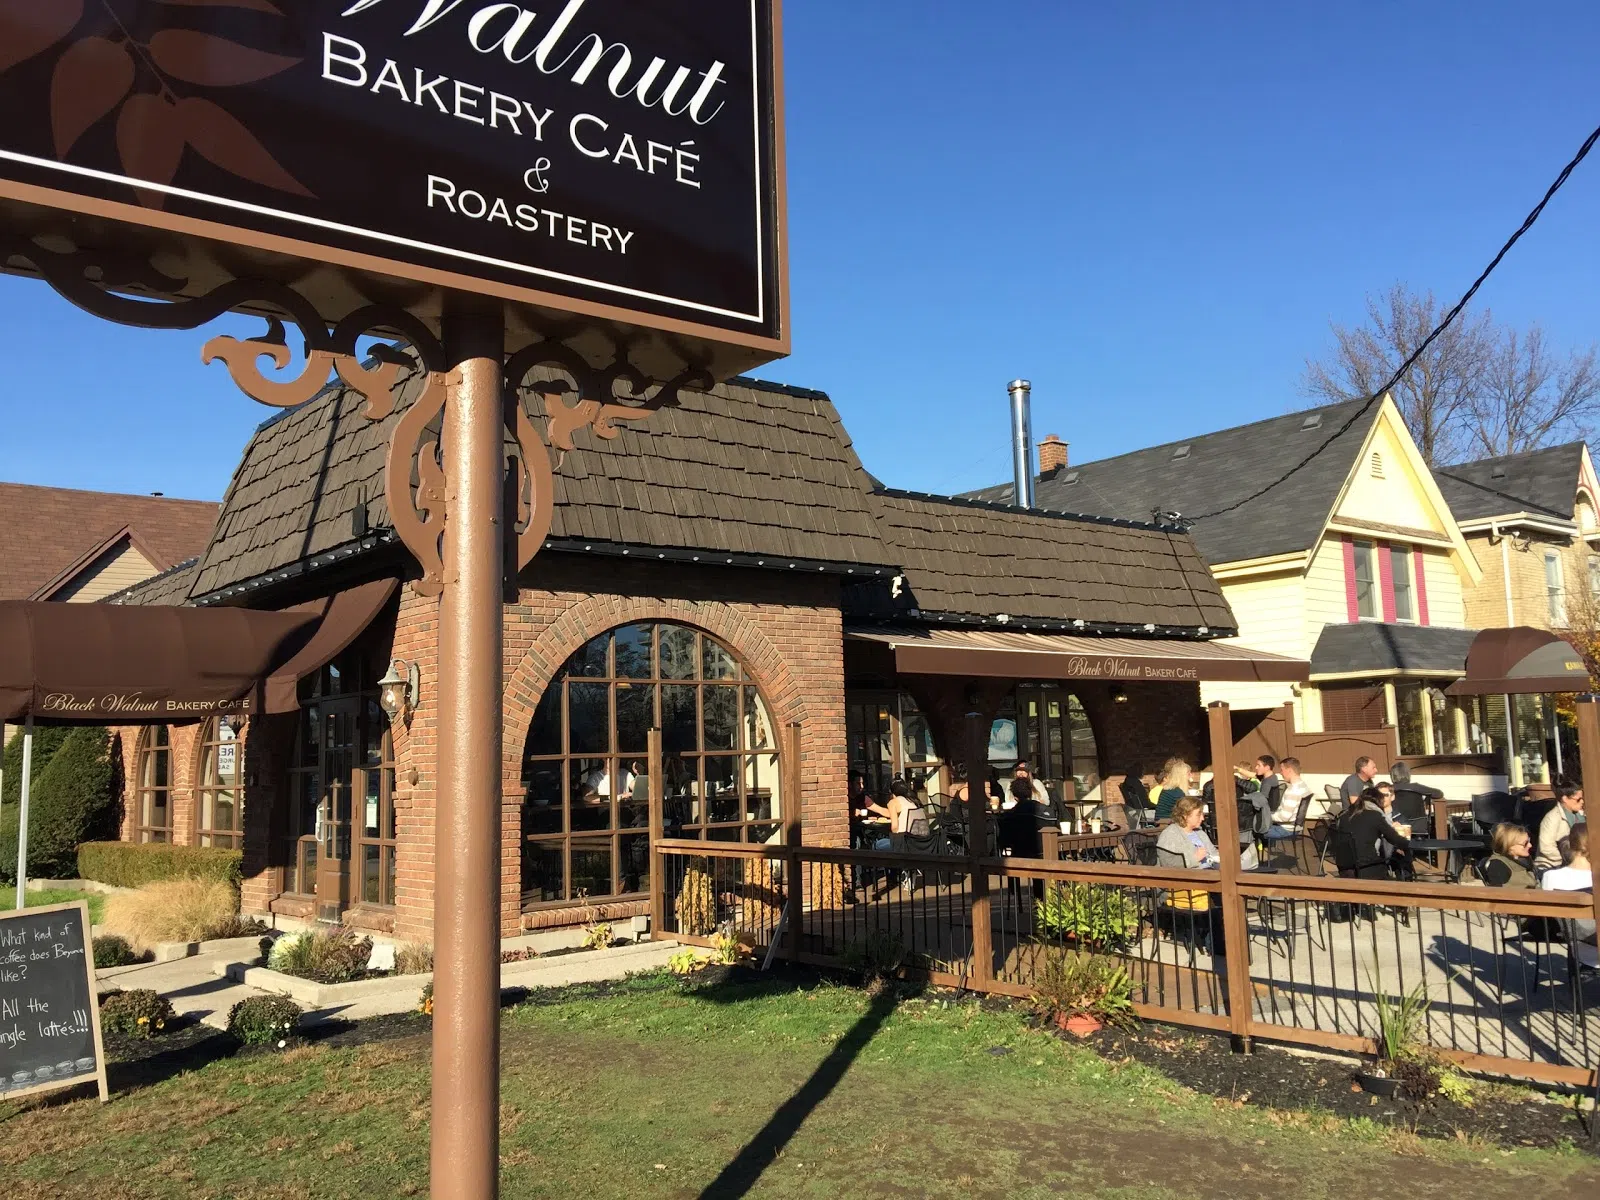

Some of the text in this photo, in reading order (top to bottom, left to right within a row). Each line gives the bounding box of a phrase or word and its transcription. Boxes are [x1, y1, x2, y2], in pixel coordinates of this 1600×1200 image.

[320, 31, 702, 190] BAKERY CAFÉ
[523, 157, 551, 194] &
[426, 174, 634, 255] ROASTERY
[1067, 656, 1198, 679] Black Walnut BAKERY CAFÉ
[42, 692, 96, 712] Black
[100, 691, 159, 712] Walnut
[166, 700, 216, 711] BAKERY
[0, 928, 26, 947] What
[60, 922, 73, 936] of
[0, 948, 26, 965] coffee
[29, 949, 50, 961] does
[0, 964, 28, 983] like?
[3, 997, 49, 1021] All the
